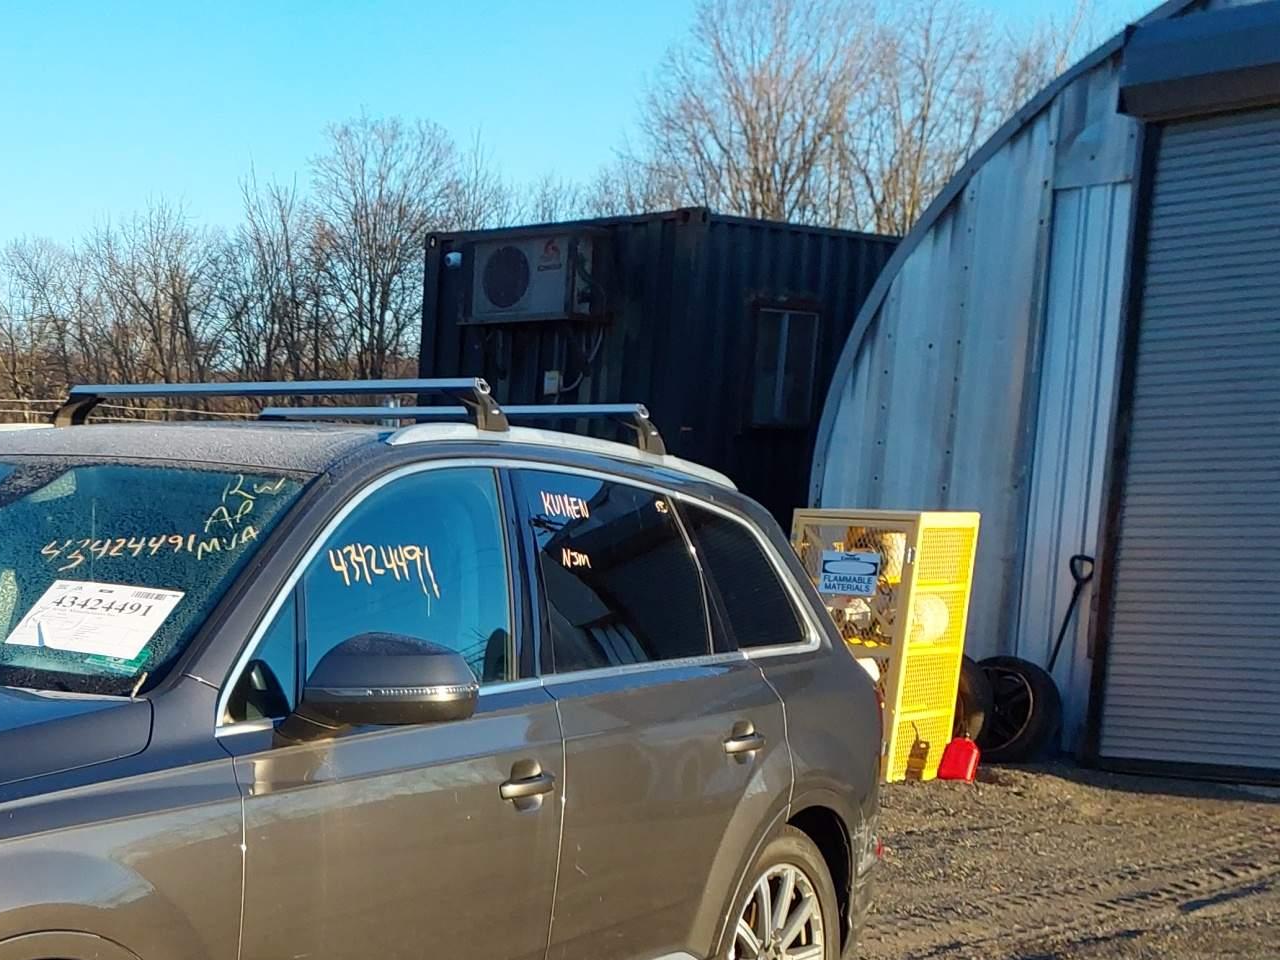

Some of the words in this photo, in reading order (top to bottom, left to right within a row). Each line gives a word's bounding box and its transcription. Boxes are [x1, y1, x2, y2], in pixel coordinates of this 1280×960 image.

[41, 534, 196, 572] 43424491
[328, 543, 440, 600] 43424491
[823, 574, 873, 585] FLAMMABLE
[824, 583, 870, 593] MATERIALS
[52, 594, 153, 617] 43424491
